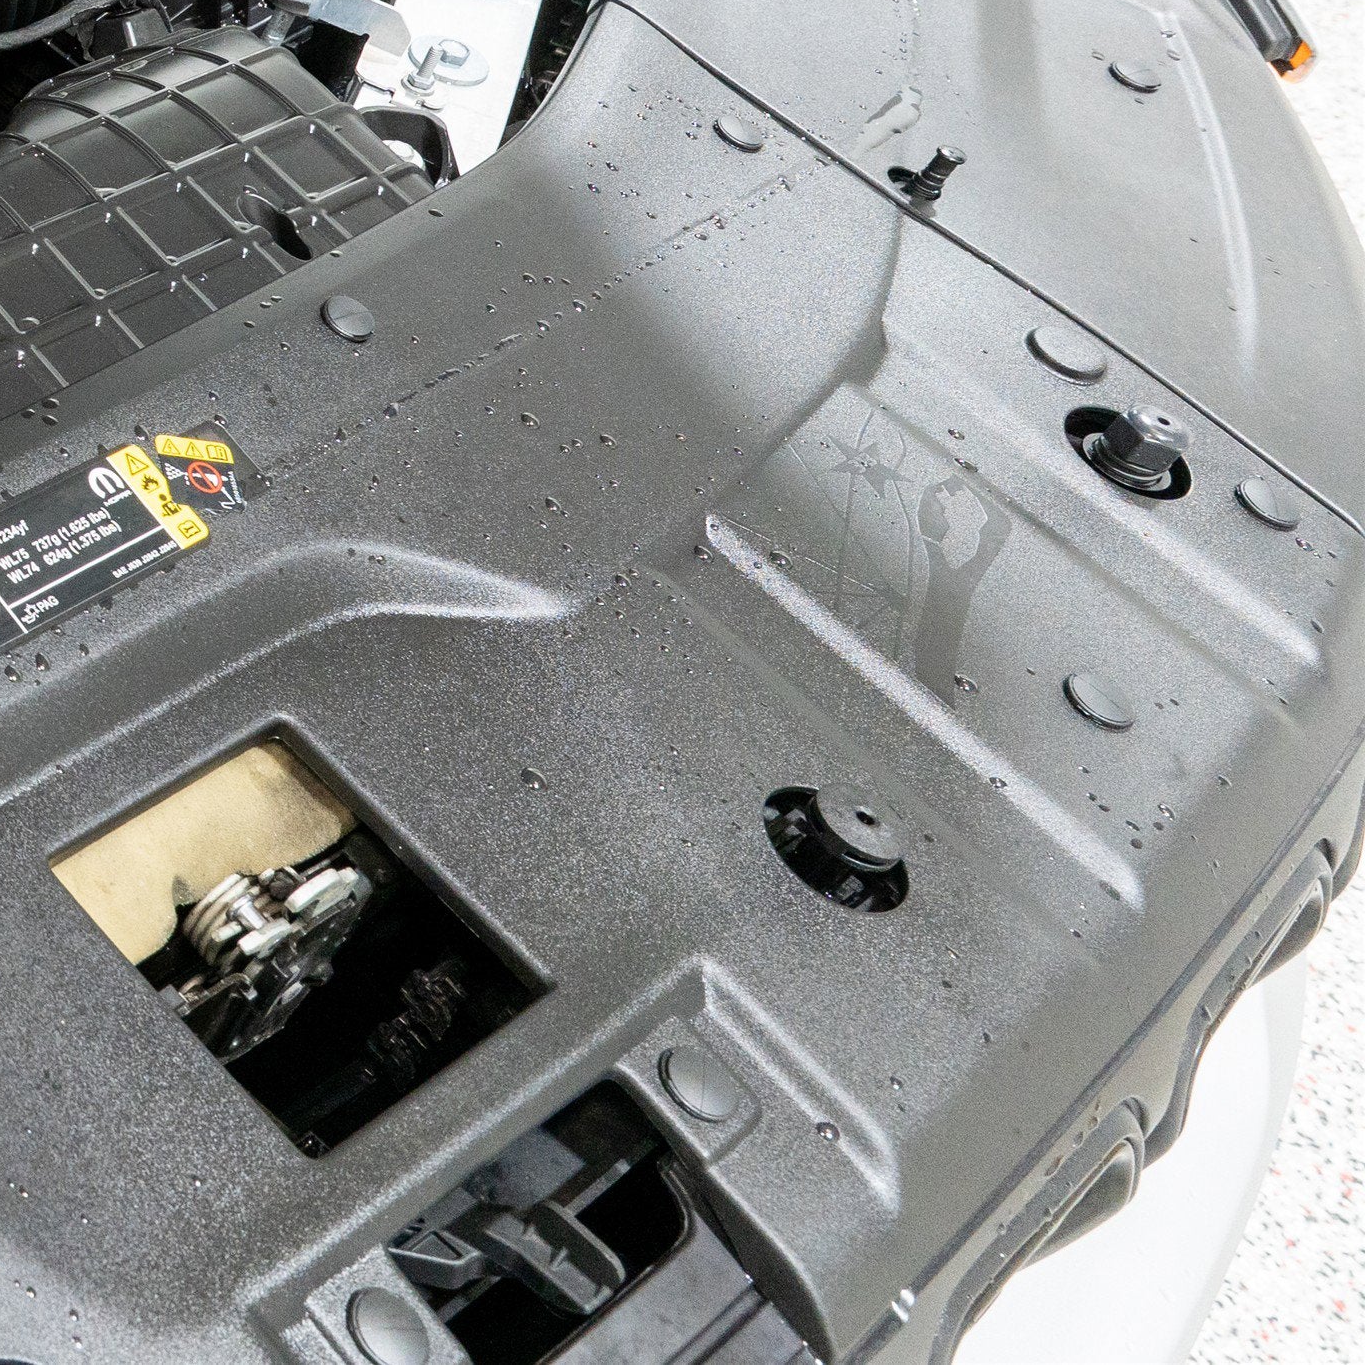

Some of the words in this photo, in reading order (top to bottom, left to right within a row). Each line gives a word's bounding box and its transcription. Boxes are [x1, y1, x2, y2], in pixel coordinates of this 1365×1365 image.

[103, 489, 133, 507] MOPAR
[31, 534, 62, 552] 737g
[58, 516, 91, 541] (1.625
[87, 506, 111, 525] lbs)
[6, 561, 41, 584] WL74
[42, 546, 72, 566] 624g
[68, 529, 102, 554] (1.375
[97, 519, 122, 538] lbs)
[112, 567, 128, 579] SAE
[36, 595, 59, 613] PAG
